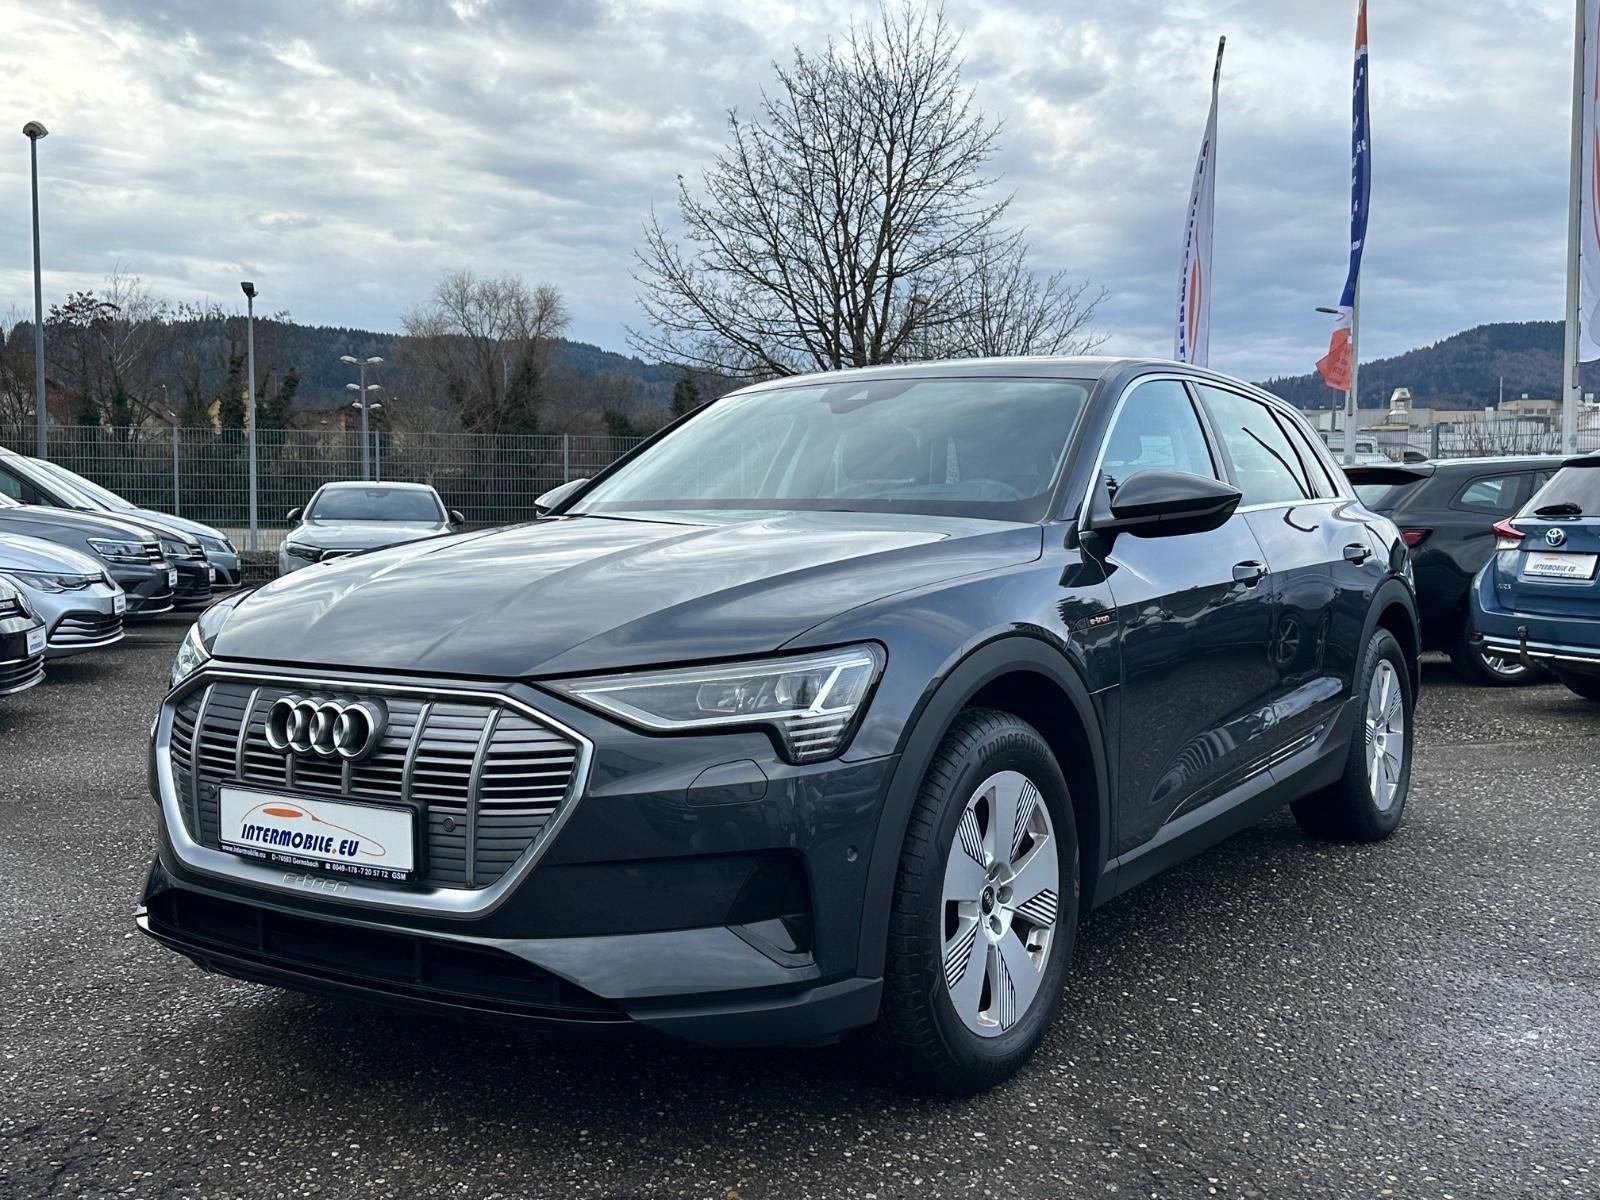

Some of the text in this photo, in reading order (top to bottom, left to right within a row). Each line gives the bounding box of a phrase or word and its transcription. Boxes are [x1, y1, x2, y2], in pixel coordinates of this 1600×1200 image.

[977, 732, 1049, 768] BRIDGESTONE
[241, 823, 360, 857] INTERMOBILE.EU
[221, 844, 267, 859] www.intermobile.eu
[391, 872, 407, 881] GSM
[282, 872, 349, 893] e-tron
